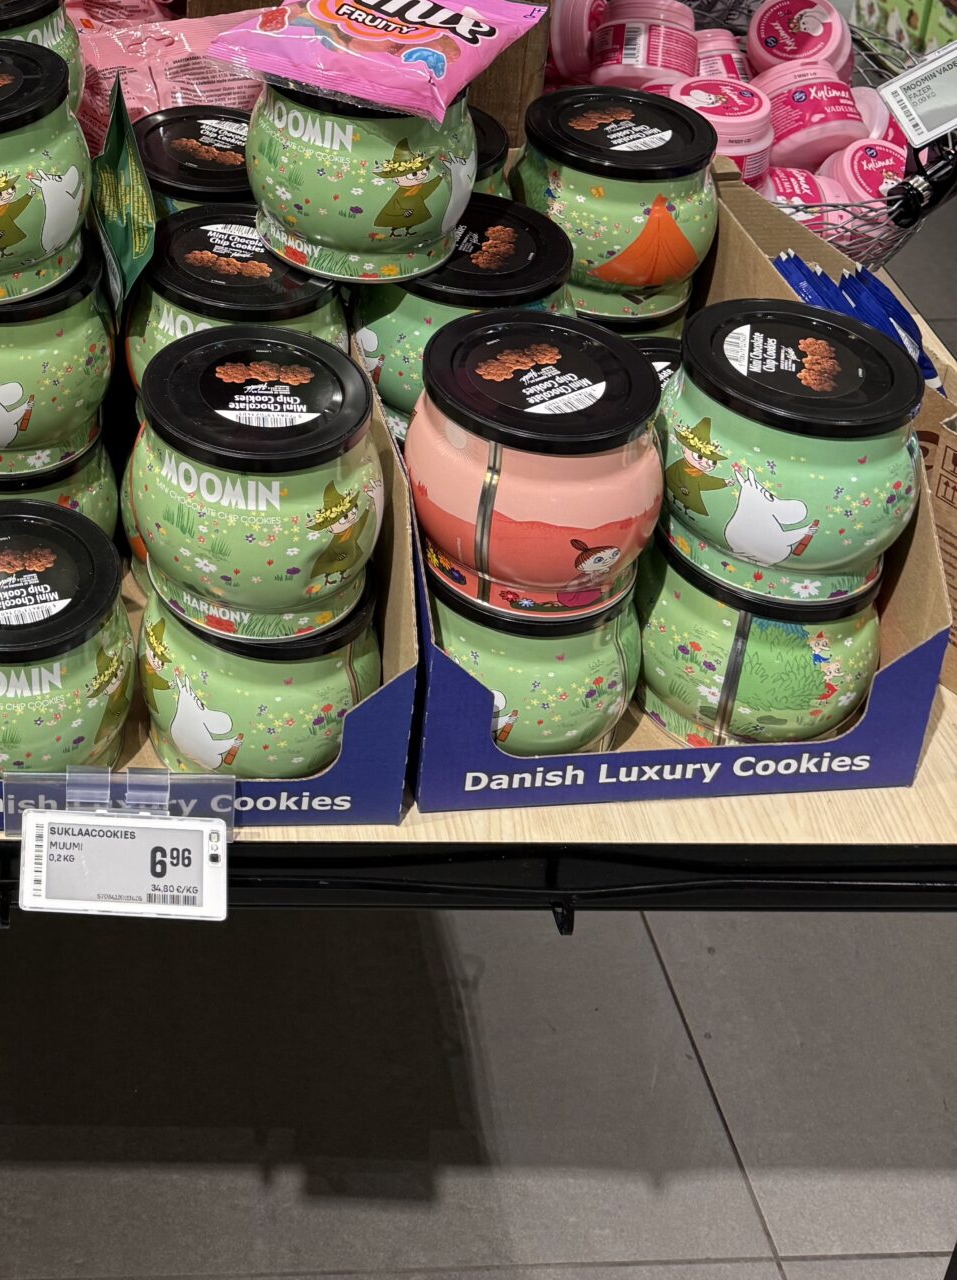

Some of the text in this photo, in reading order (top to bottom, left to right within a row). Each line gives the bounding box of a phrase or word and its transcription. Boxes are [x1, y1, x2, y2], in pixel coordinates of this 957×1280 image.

[337, 3, 418, 35] FRUITY
[902, 71, 937, 94] MOOMIN
[907, 84, 932, 100] FAZER
[263, 100, 354, 153] MOOMIN
[270, 226, 323, 258] HARMONY
[228, 401, 307, 413] Mini Chocolate
[233, 394, 301, 405] Chip Cookies
[160, 449, 281, 512] MOOMIN
[240, 515, 282, 526] COOKIES
[27, 583, 51, 594] Chip
[36, 591, 60, 602] Mini
[182, 591, 251, 624] HARMONY
[5, 702, 26, 711] CHIP
[27, 694, 65, 710] COOKIES
[463, 751, 872, 793] Danish Luxury Cookies
[210, 792, 353, 815] Cookies
[49, 826, 137, 841] SUKLAACOOKIES
[49, 841, 83, 851] MUUMI
[63, 854, 76, 863] KG
